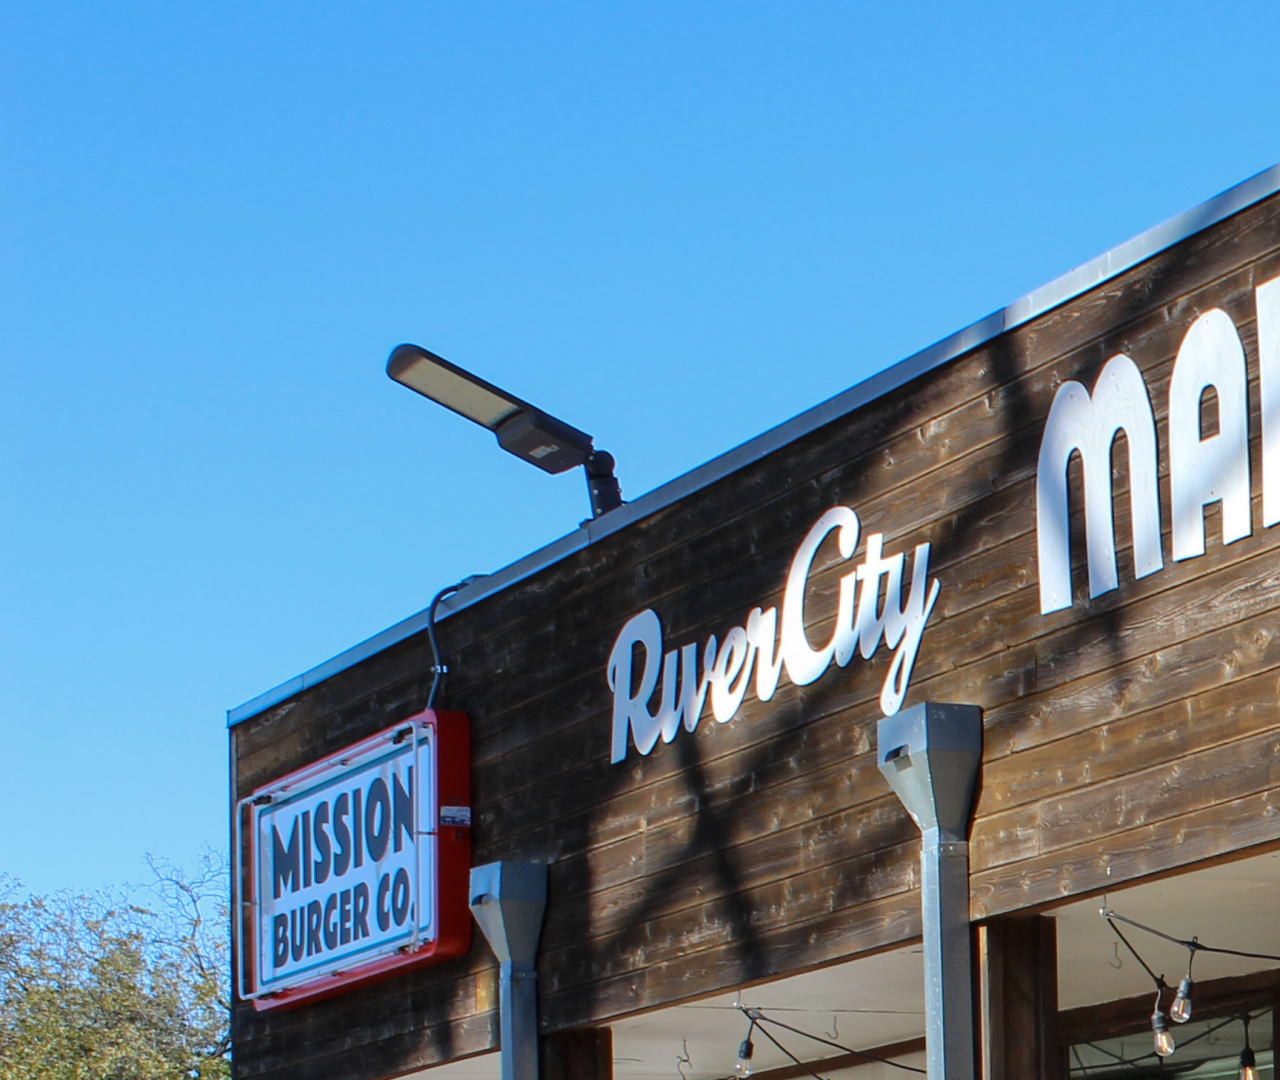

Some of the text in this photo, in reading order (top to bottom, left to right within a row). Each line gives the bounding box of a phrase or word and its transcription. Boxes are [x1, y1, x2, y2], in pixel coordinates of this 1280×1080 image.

[272, 765, 416, 900] MISSION
[273, 866, 416, 968] BURGER CO.
